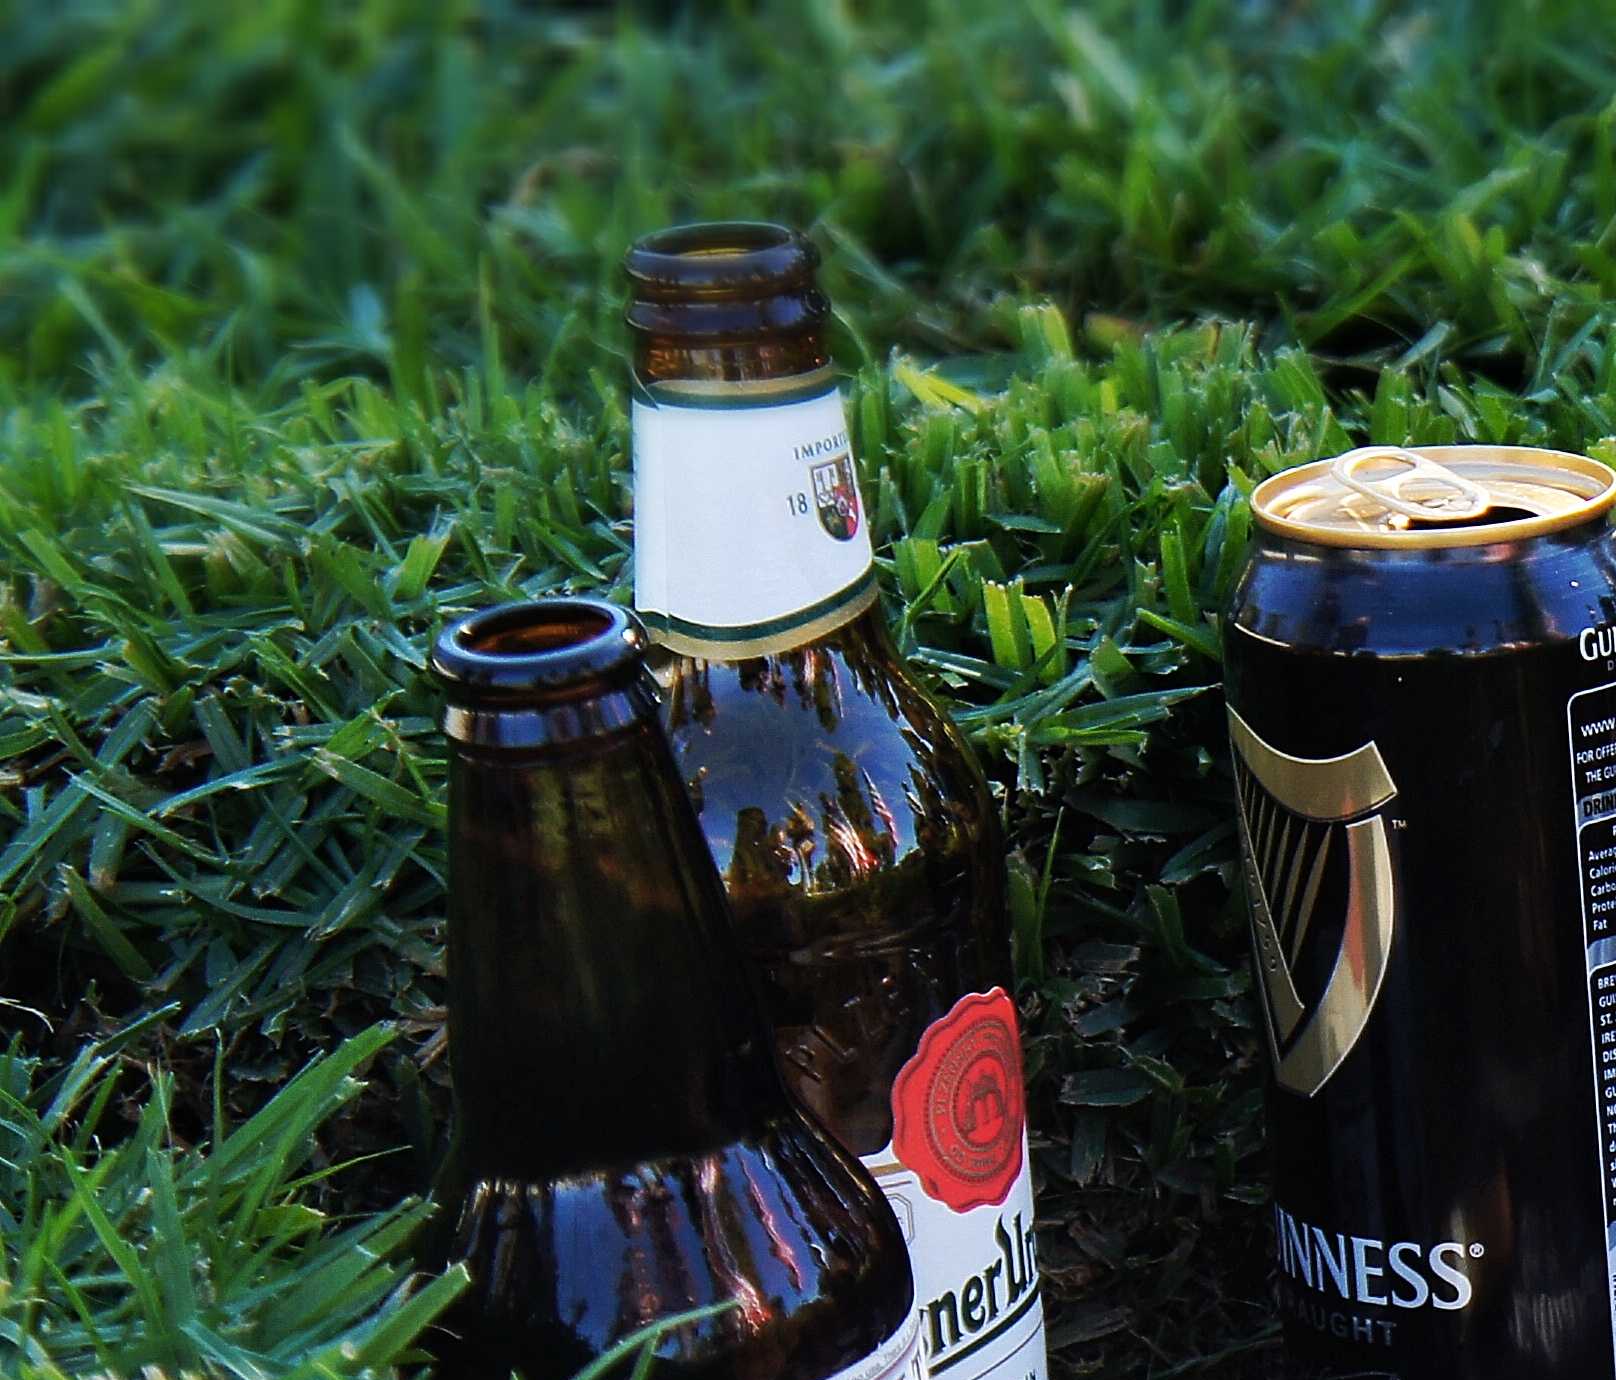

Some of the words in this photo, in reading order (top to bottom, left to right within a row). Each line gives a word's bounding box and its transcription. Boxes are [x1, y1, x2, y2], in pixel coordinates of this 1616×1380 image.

[785, 493, 808, 516] 18
[1585, 769, 1602, 783] THE
[1593, 919, 1608, 931] Fat
[1276, 1204, 1473, 1310] INNESS
